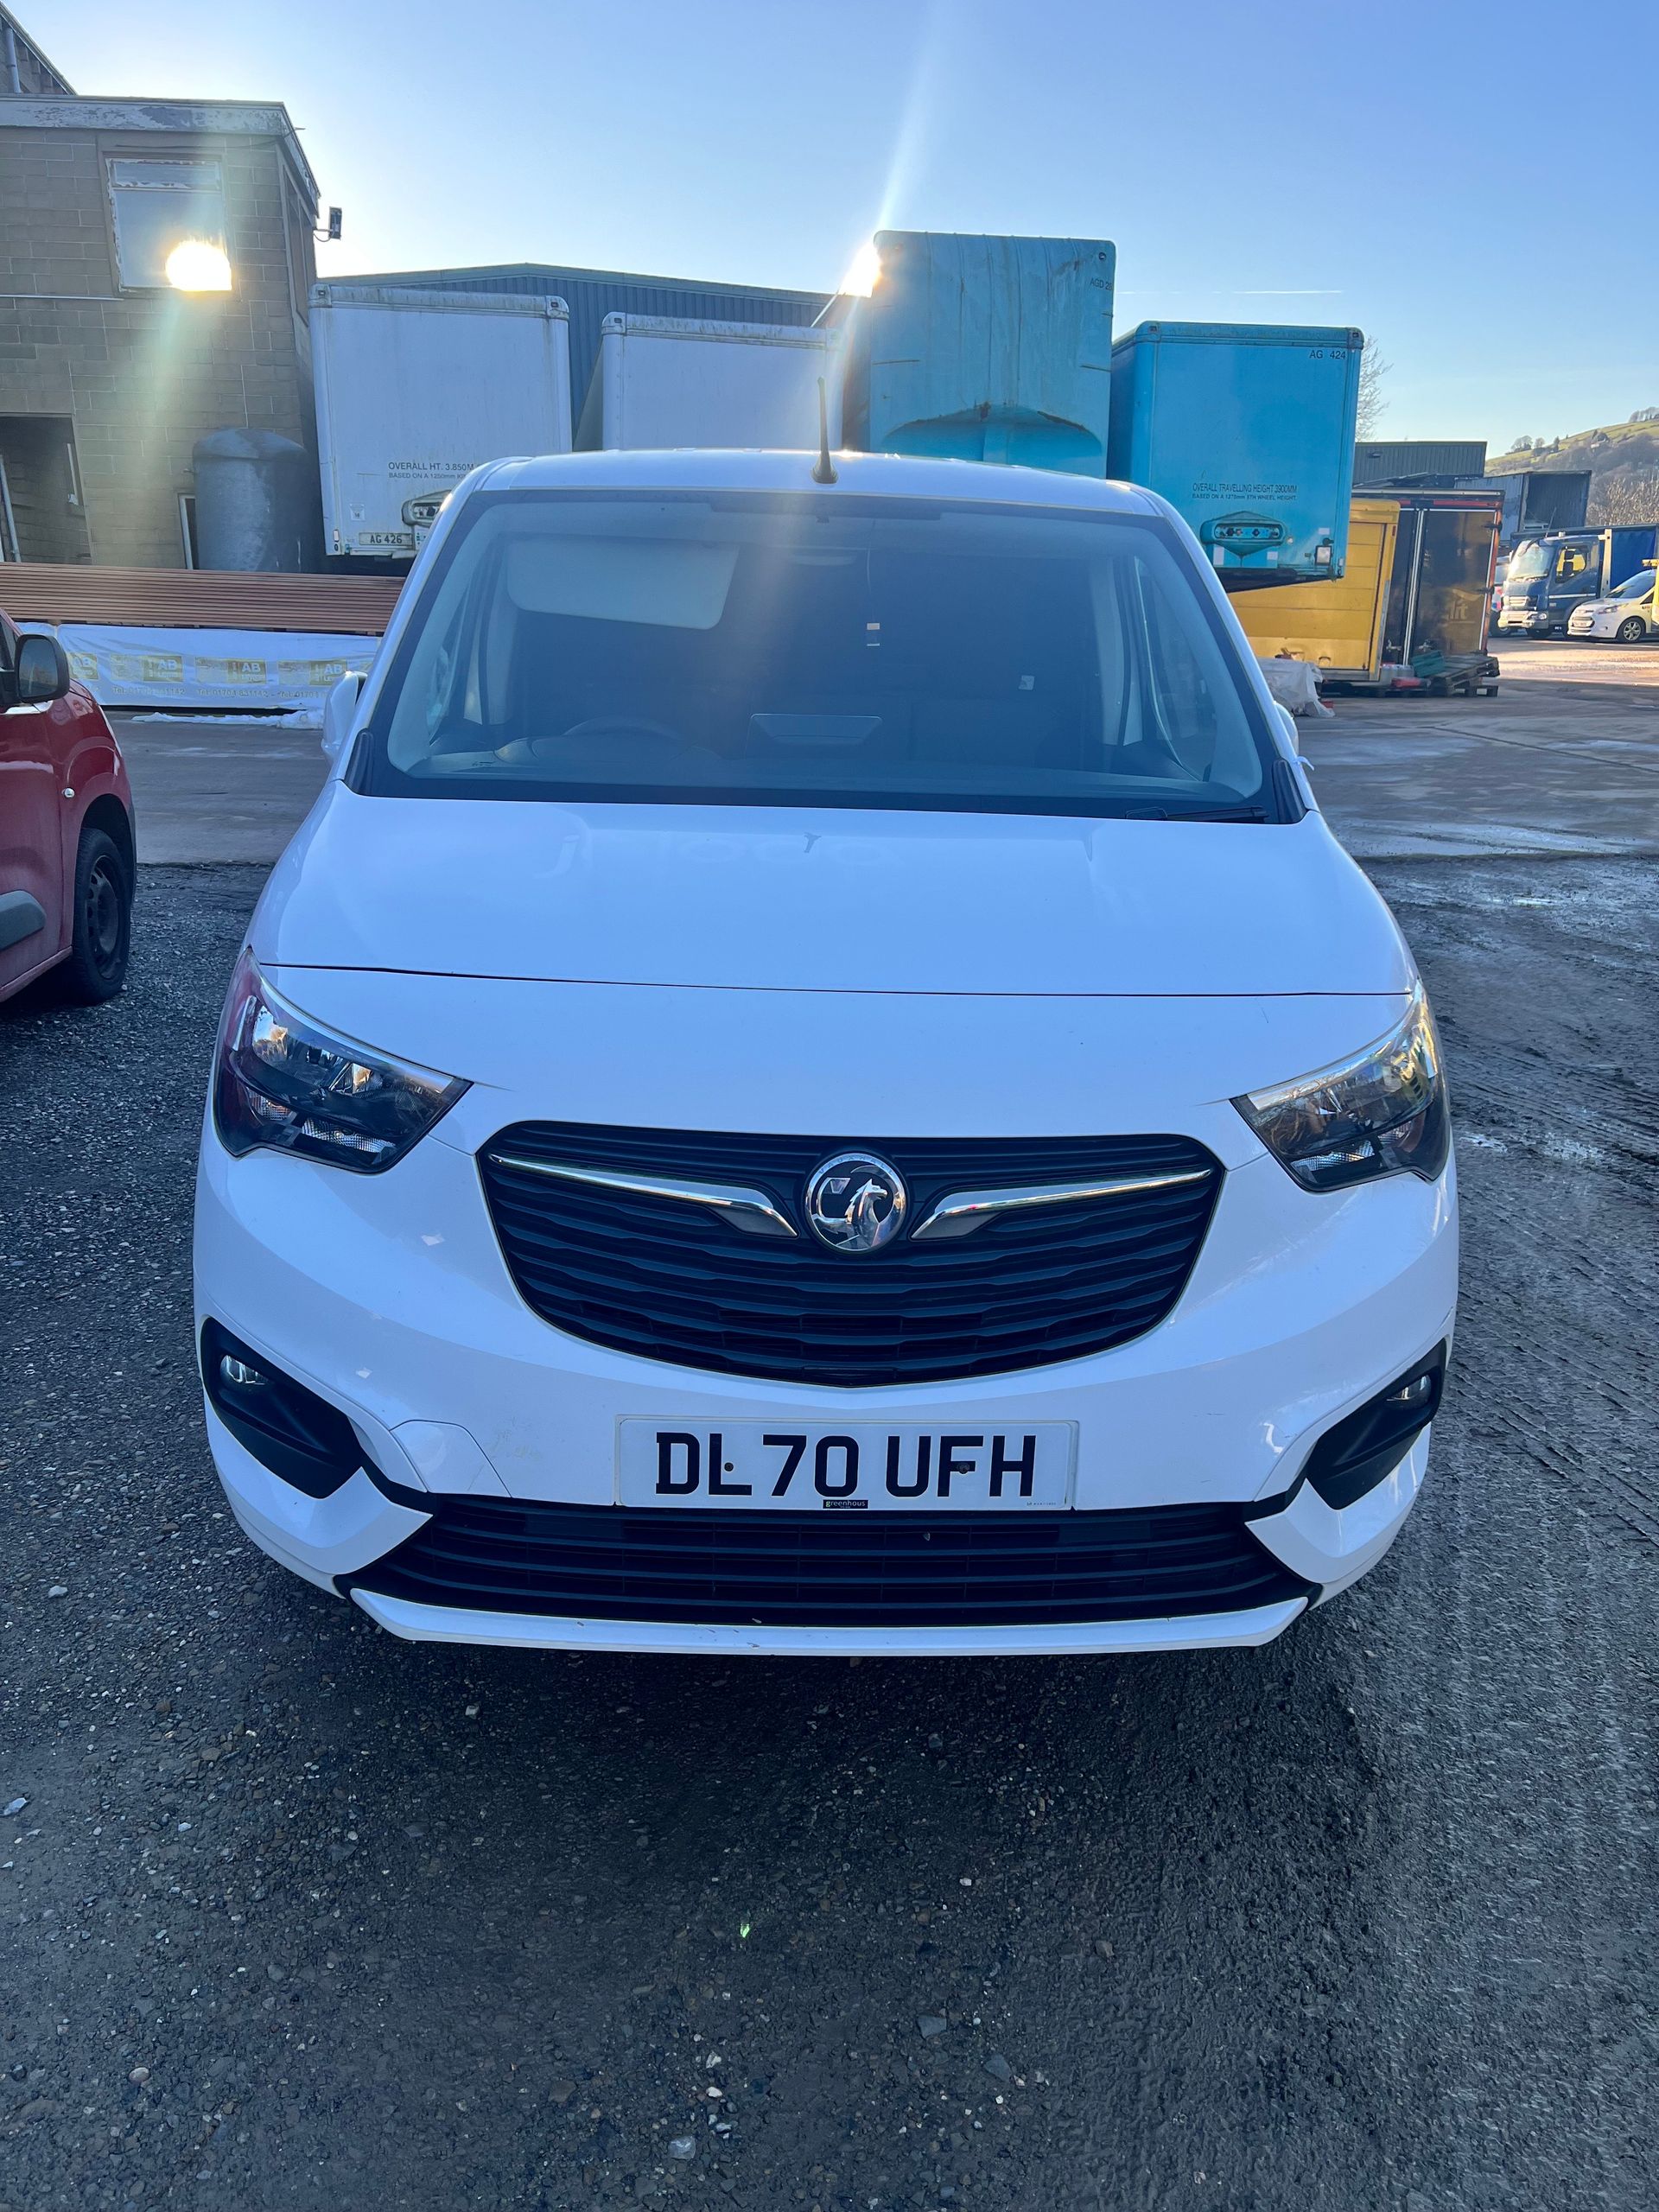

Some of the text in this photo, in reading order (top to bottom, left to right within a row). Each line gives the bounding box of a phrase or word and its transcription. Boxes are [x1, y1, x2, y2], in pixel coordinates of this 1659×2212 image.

[1309, 349, 1346, 359] AG 424
[388, 461, 428, 470] OVERALL
[429, 462, 443, 471] HT.
[1192, 482, 1217, 492] OVERALL
[1218, 483, 1252, 493] TRAVELLING
[1253, 484, 1274, 493] HEIGHT
[370, 534, 403, 544] AG 426
[242, 662, 261, 672] AB
[324, 664, 343, 675] AB
[655, 1432, 1037, 1498] DL70 UFH
